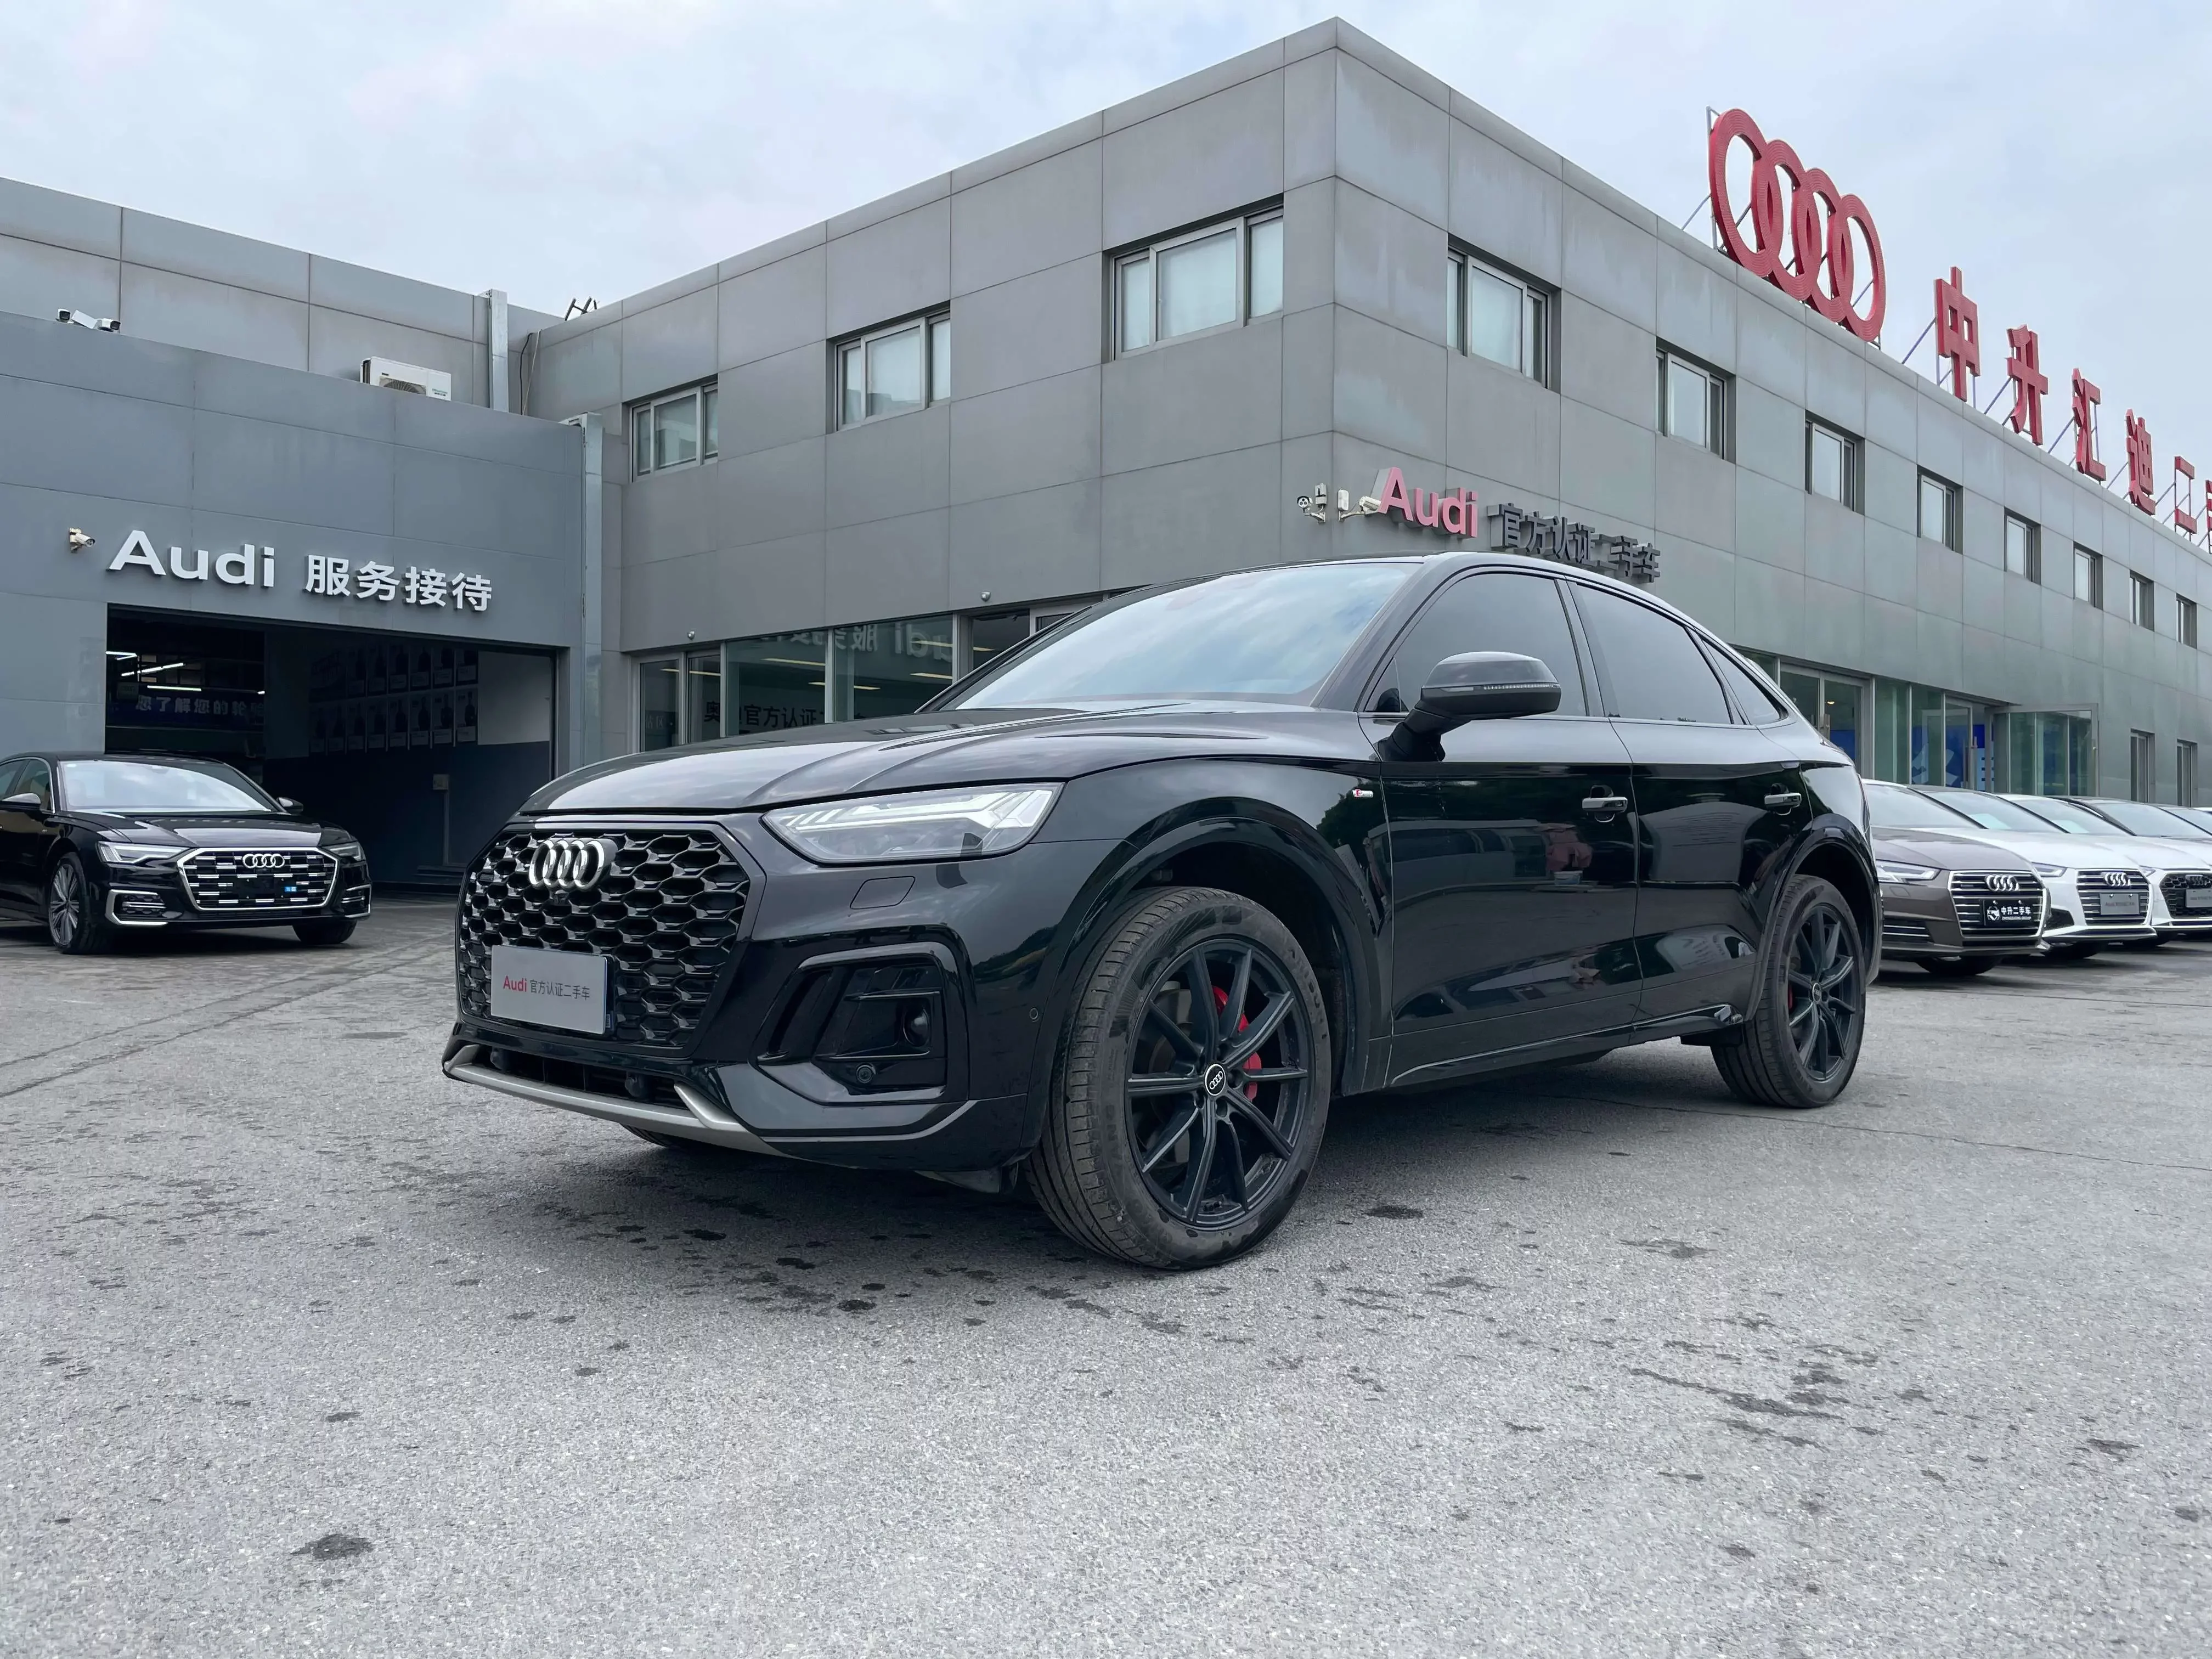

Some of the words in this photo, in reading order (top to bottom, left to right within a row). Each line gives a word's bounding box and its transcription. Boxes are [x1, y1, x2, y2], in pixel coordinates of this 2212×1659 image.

[1933, 266, 2212, 534] 中升汇迪二
[1375, 467, 1478, 538] Audi
[1487, 503, 1661, 583] 官方认证二手车
[108, 530, 274, 588] Audi
[305, 555, 492, 611] 服务接待
[2001, 906, 2031, 916] 中升二手车
[503, 974, 527, 992] Audi
[529, 979, 591, 1001] 官方认证二手车
